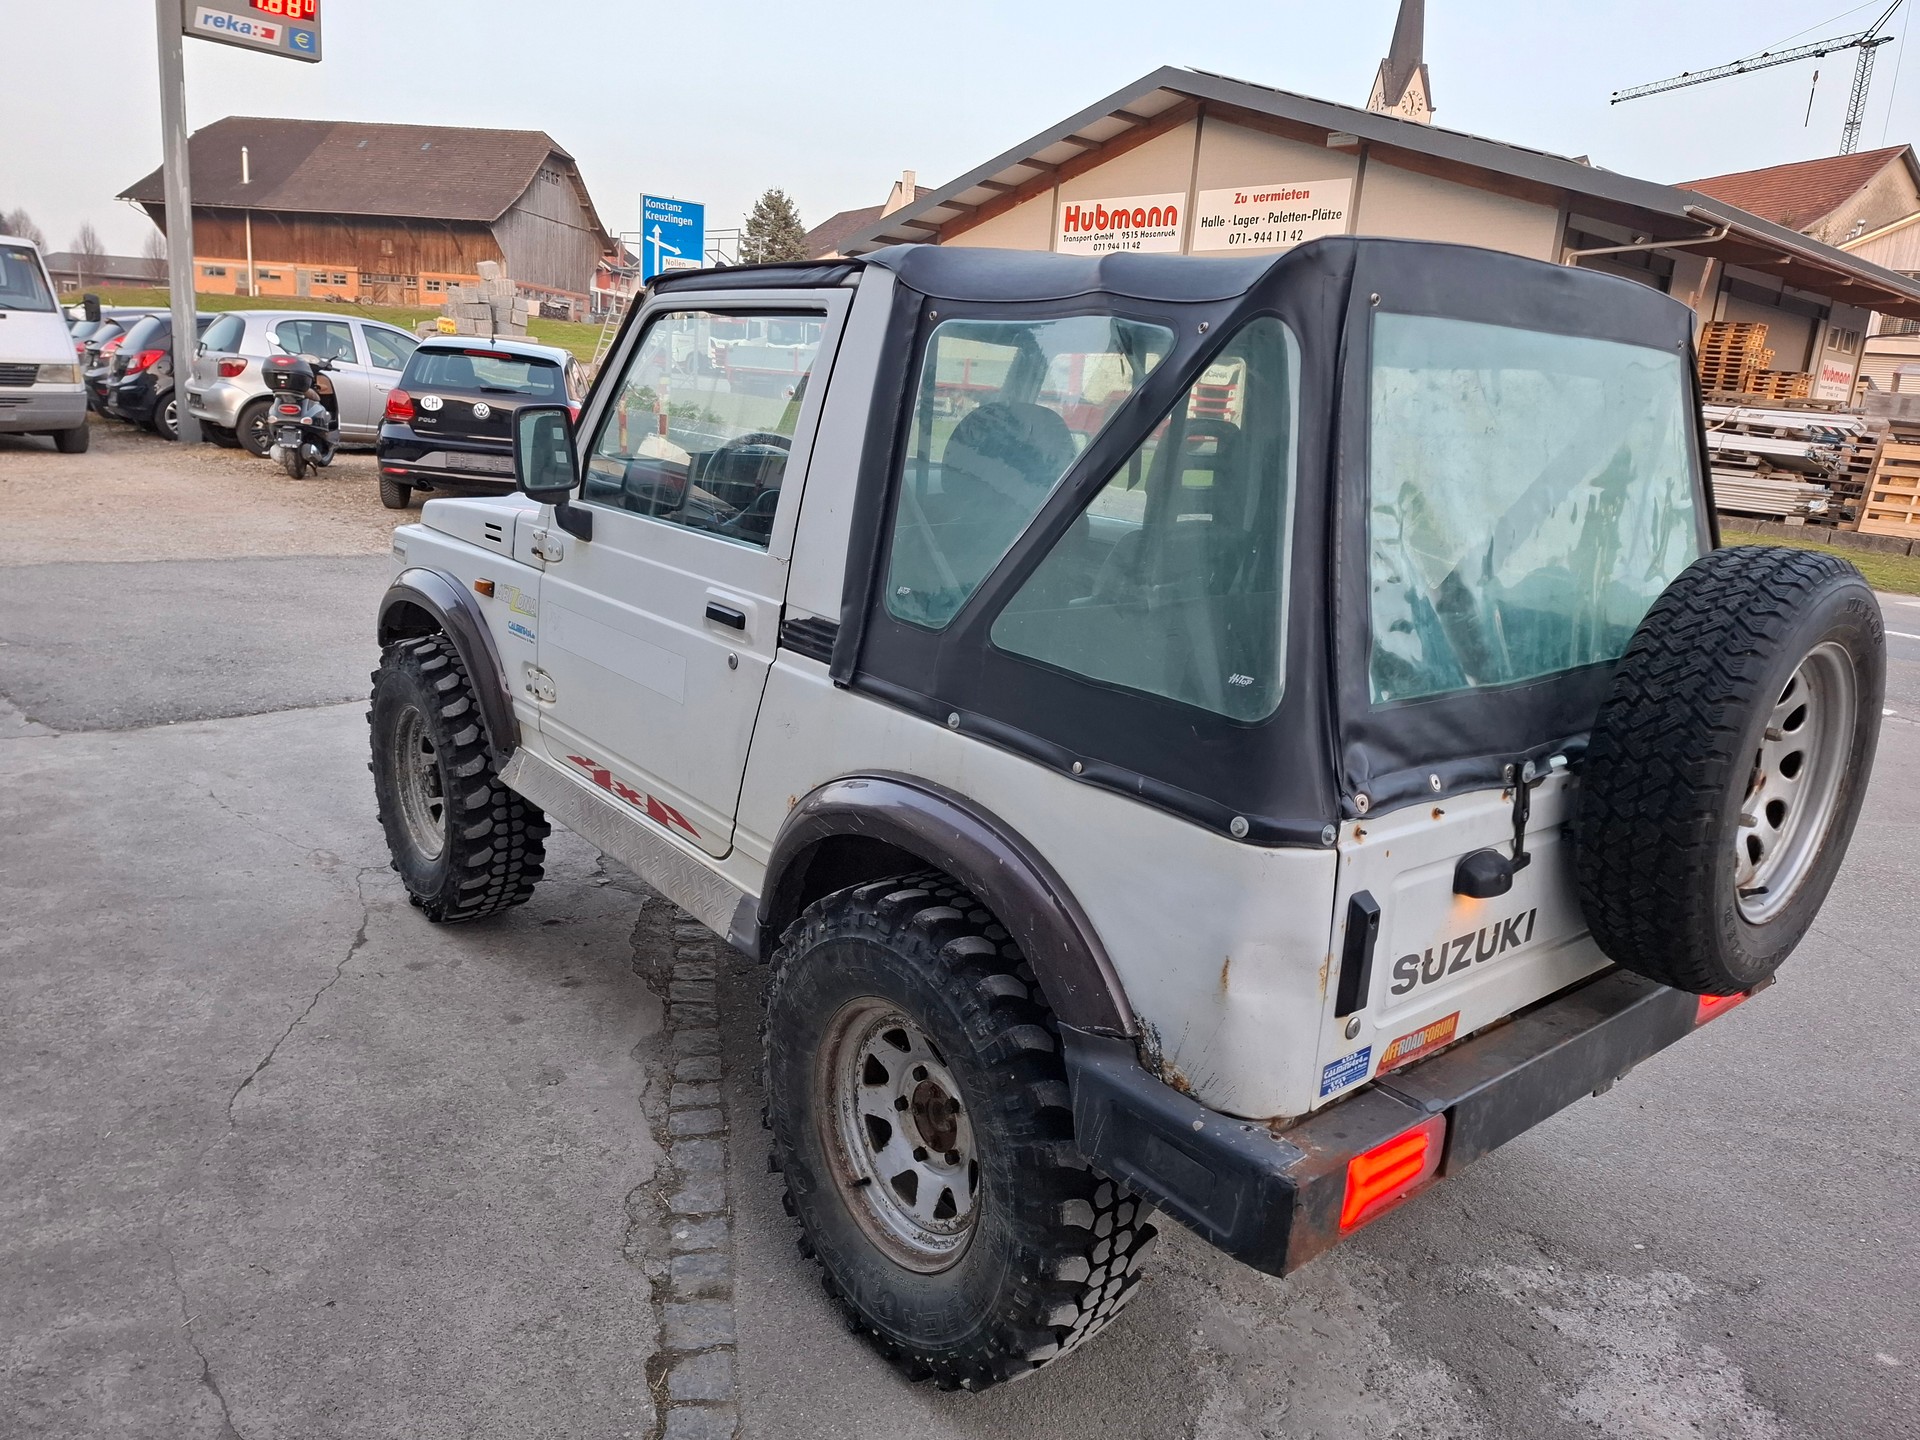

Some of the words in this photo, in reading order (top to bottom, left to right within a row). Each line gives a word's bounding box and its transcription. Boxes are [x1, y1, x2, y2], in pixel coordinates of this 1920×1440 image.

[1234, 193, 1247, 204] Zu
[1253, 188, 1310, 203] vermieten
[645, 198, 683, 213] Konstanz
[645, 210, 693, 227] Kreuzlingen
[1064, 204, 1178, 232] Hubmann
[1201, 216, 1225, 228] Halle
[1233, 214, 1260, 228] Lager
[1267, 208, 1342, 224] Paletten-Plätze
[1063, 234, 1092, 243] Transport
[1094, 232, 1114, 241] GmbH
[1121, 231, 1139, 240] 9515
[1276, 231, 1287, 242] 11
[1290, 230, 1304, 241] 42
[1093, 243, 1105, 251] 071
[1107, 242, 1120, 250] 944
[1122, 242, 1130, 250] 11
[1131, 241, 1141, 249] 42
[665, 258, 686, 267] Nollen
[1822, 364, 1851, 384] Hubmann
[424, 398, 439, 408] CH
[1391, 908, 1537, 995] SUZUKI
[1382, 1016, 1456, 1063] OFFROADFORUM
